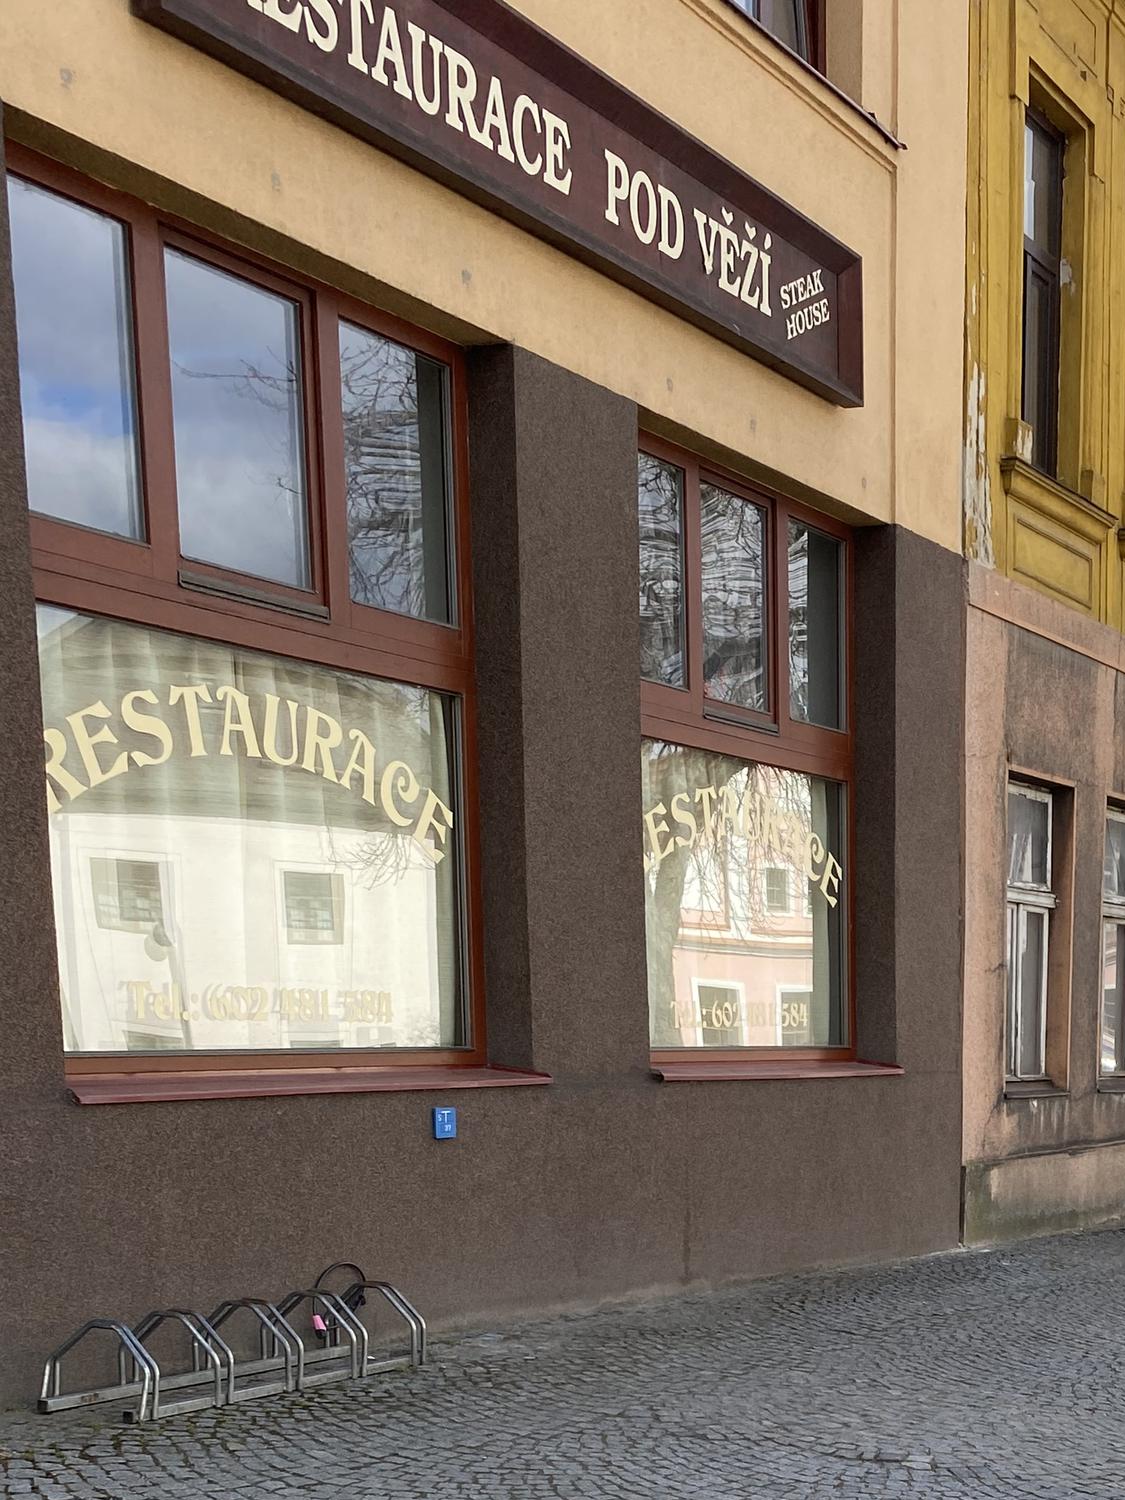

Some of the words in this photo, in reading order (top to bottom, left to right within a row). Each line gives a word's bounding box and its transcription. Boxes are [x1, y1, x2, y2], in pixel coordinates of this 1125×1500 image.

[246, 0, 573, 196] STAURACE
[604, 148, 685, 260] POD
[693, 206, 773, 318] VĚŽÍ
[779, 268, 825, 310] STEAK
[786, 298, 831, 340] HOUSE
[43, 683, 454, 865] RESTAURACE
[643, 785, 843, 909] ESTAURACE
